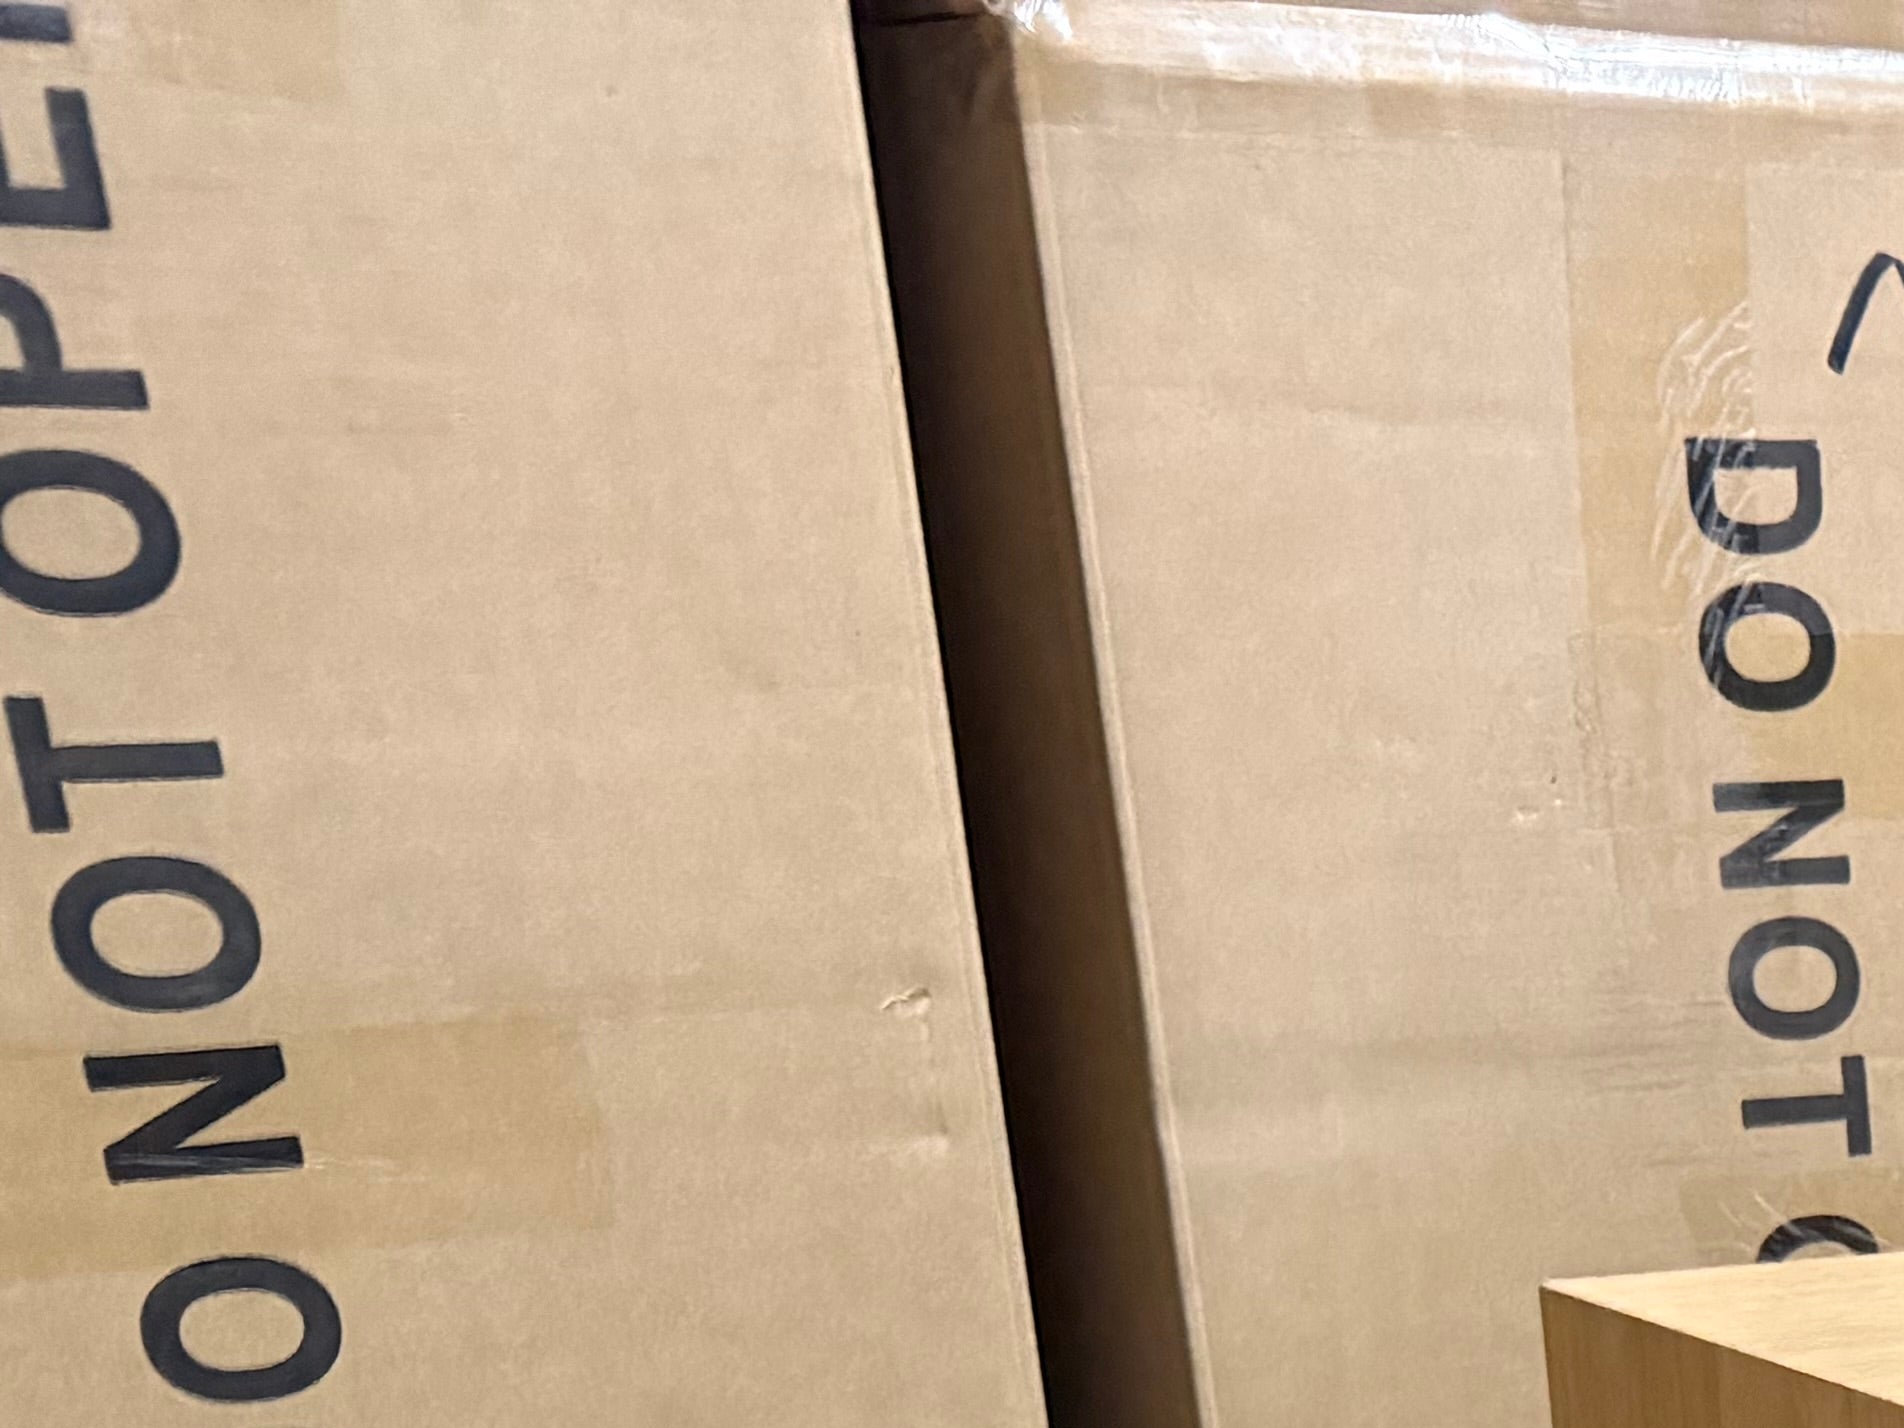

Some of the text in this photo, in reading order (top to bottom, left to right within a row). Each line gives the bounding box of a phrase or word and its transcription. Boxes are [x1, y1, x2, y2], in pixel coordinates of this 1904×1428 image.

[0, 0, 181, 617] OPE
[1685, 437, 1838, 712] DO
[3, 694, 304, 1186] NOT
[1712, 778, 1873, 1158] NOT
